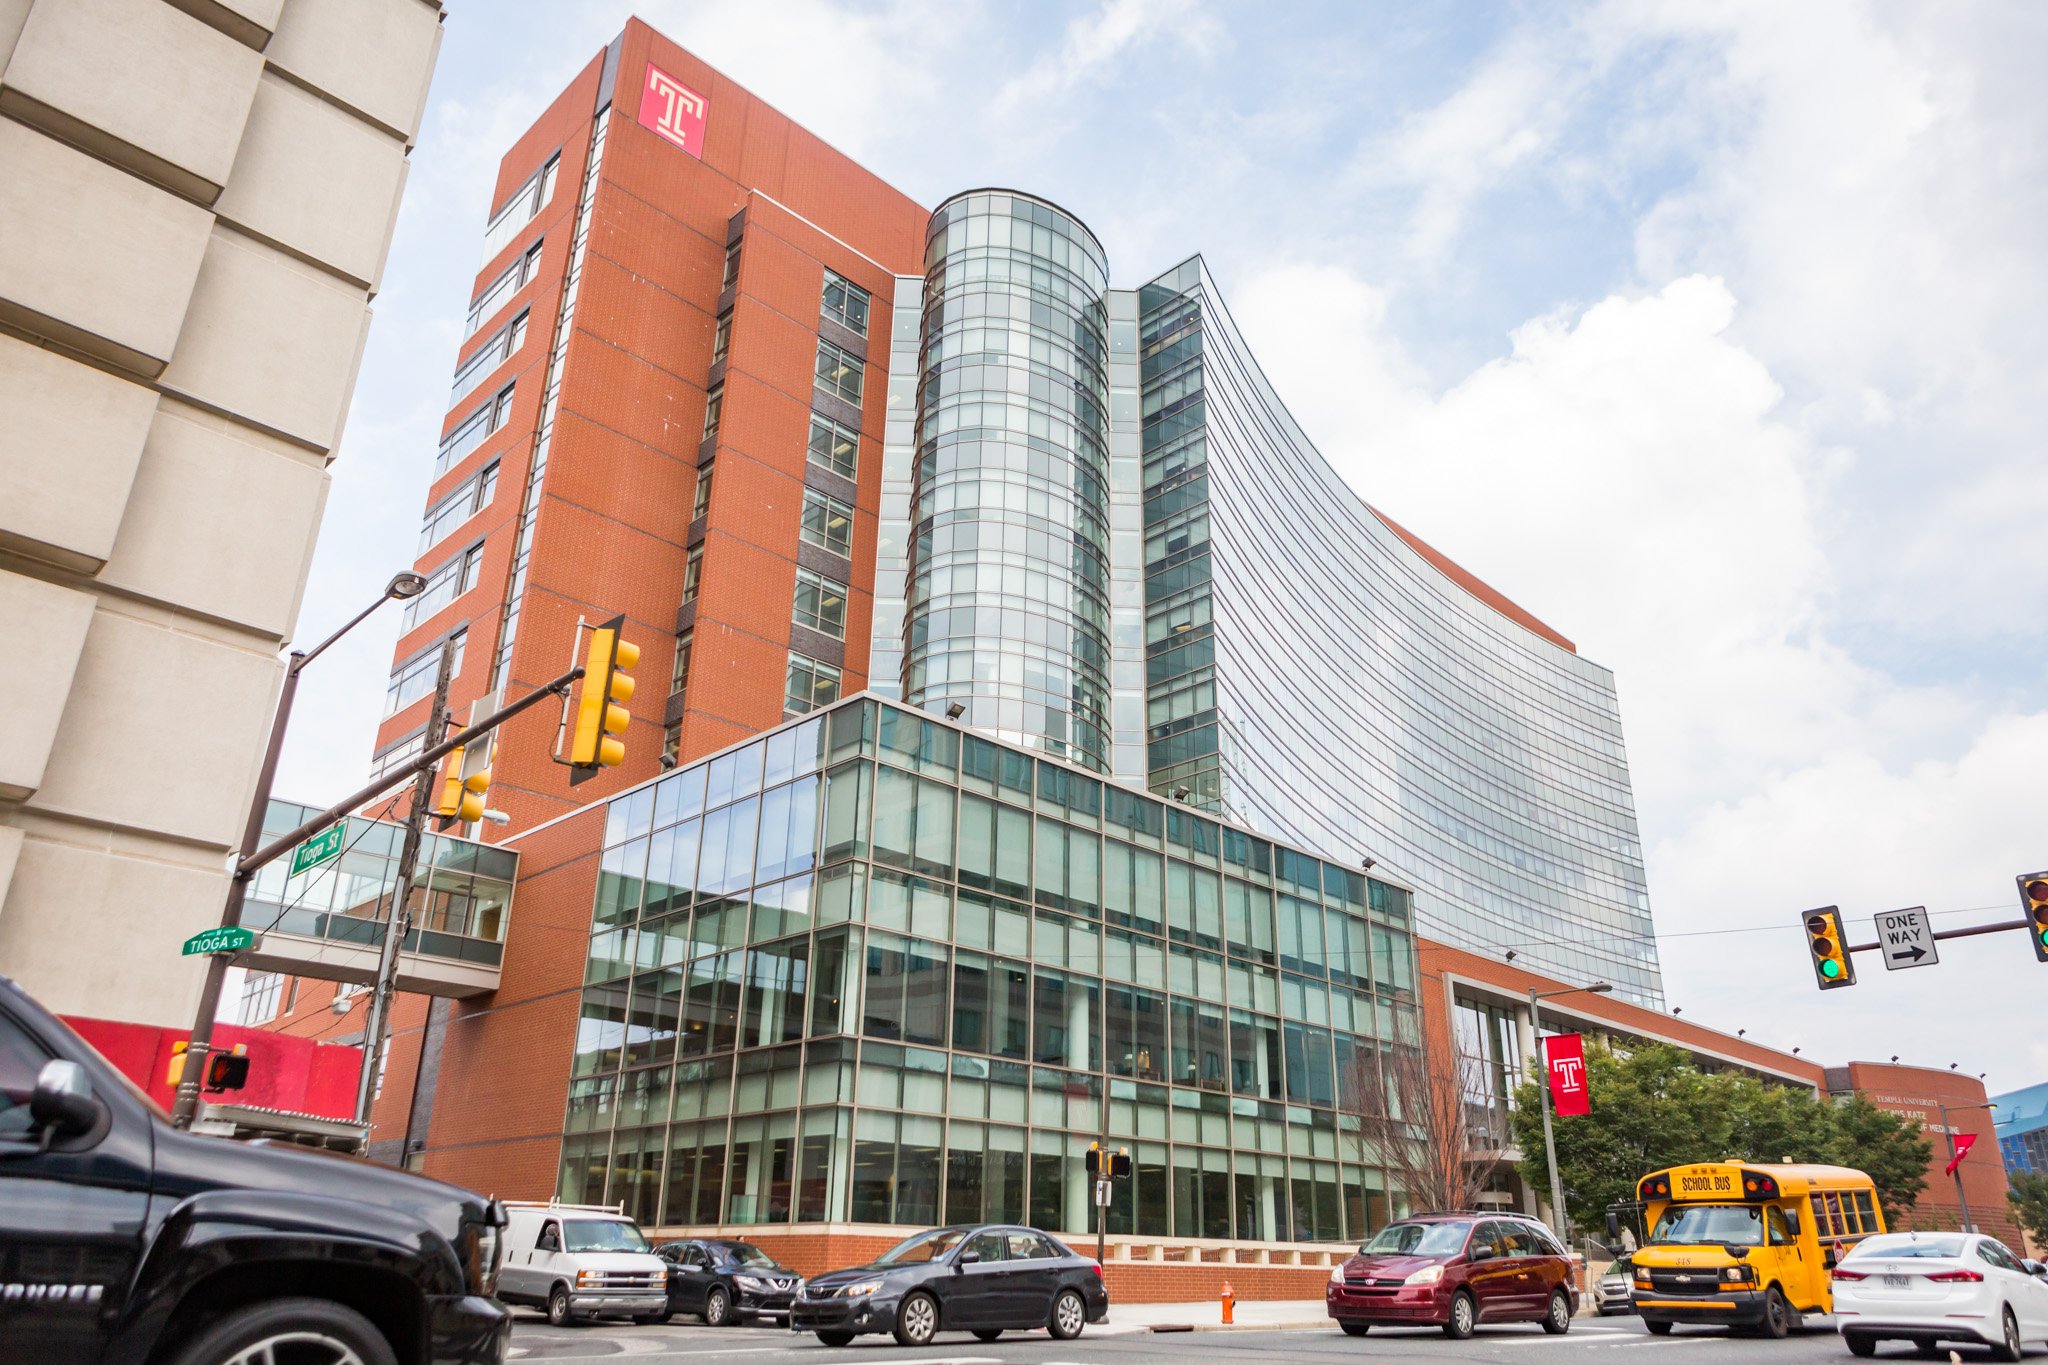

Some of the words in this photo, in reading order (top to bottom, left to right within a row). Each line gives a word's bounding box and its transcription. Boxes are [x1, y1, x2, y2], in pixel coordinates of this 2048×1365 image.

[649, 68, 704, 147] T
[300, 842, 325, 866] Tioga
[326, 831, 340, 852] St
[1885, 913, 1918, 930] ONE
[190, 936, 228, 953] TIOGA
[232, 937, 245, 947] ST
[1887, 928, 1921, 945] WAY
[1552, 1057, 1583, 1093] T
[1876, 1096, 1902, 1105] TEMPLE
[1903, 1097, 1938, 1107] UNIVERSITY
[1906, 1110, 1928, 1121] KATZ
[1682, 1177, 1713, 1192] SCHOOL
[1714, 1175, 1731, 1191] BUS
